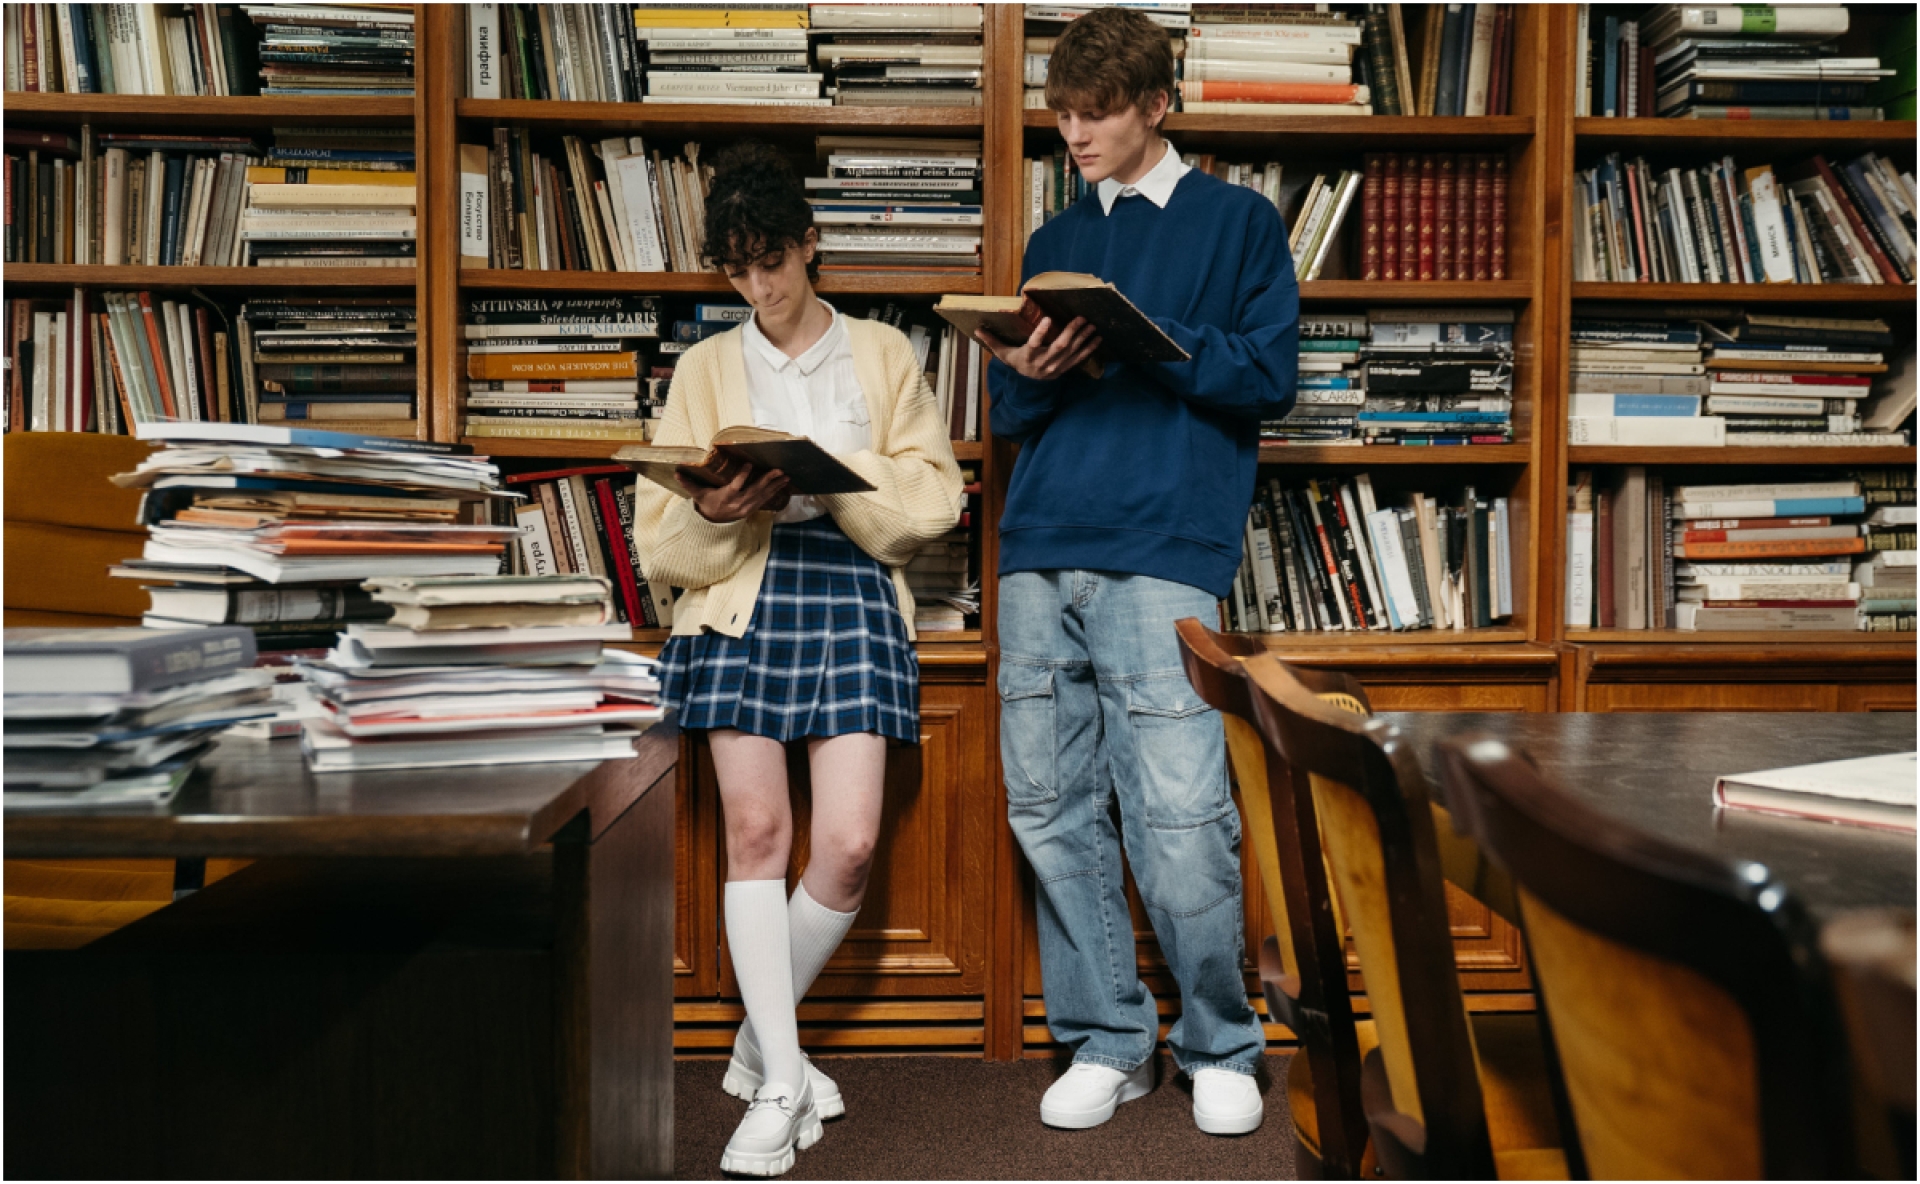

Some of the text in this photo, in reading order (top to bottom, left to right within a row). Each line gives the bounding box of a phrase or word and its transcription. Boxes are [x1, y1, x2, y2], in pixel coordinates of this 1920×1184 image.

[477, 26, 492, 86] графика
[475, 192, 484, 240] Искусство
[472, 298, 623, 312] Splendeurs de VERSAILLES
[540, 314, 596, 324] Splendeurs
[616, 312, 657, 324] PARIS
[559, 324, 650, 335] KOPENHAGEN
[536, 363, 556, 371] VON
[559, 362, 610, 371] MOSAIKEN
[612, 362, 628, 370] DIE
[1312, 392, 1359, 402] SCARPA
[615, 490, 632, 526] France
[624, 526, 634, 540] de
[530, 541, 546, 577] тура
